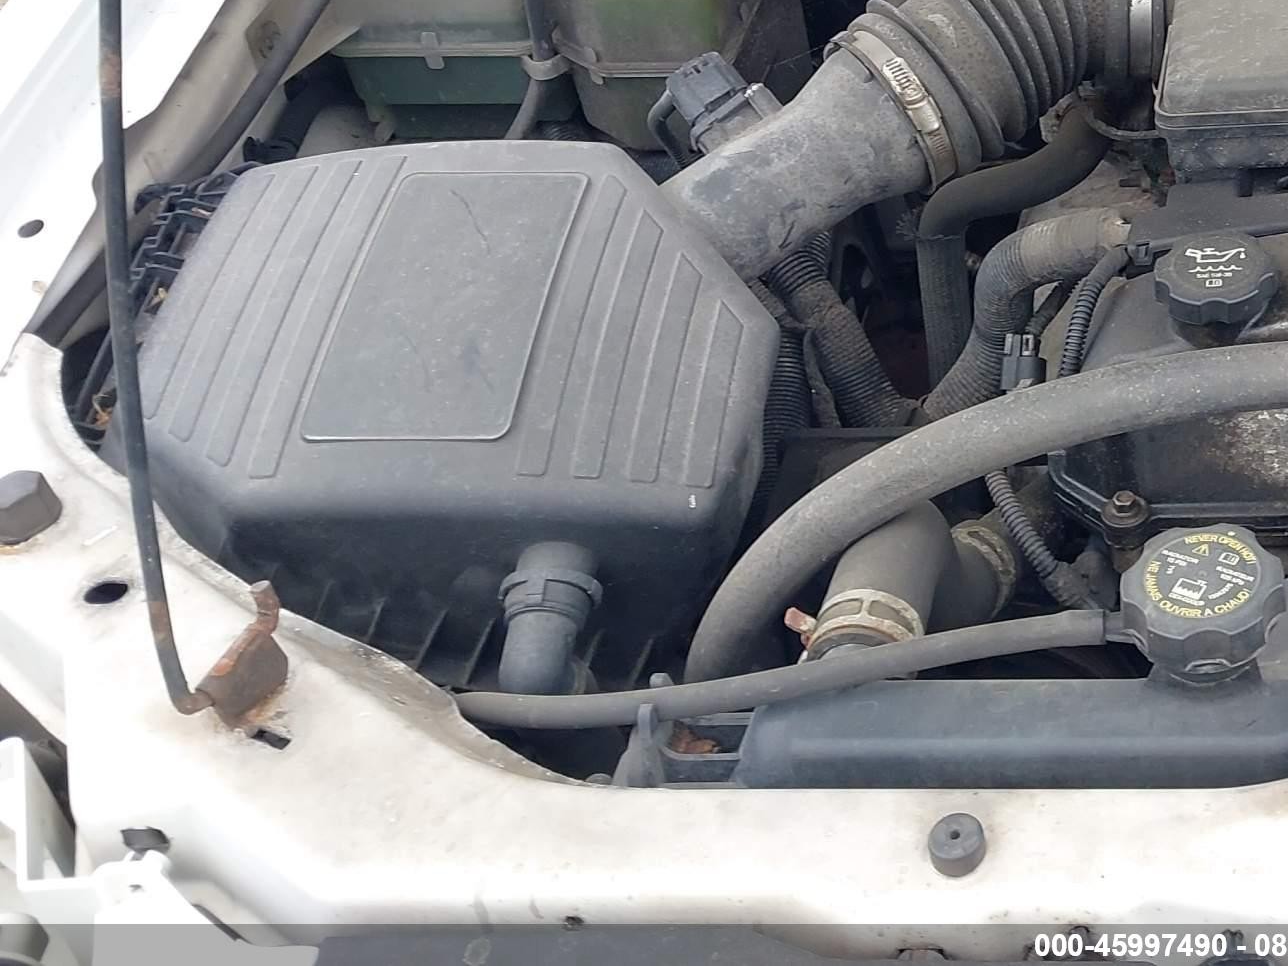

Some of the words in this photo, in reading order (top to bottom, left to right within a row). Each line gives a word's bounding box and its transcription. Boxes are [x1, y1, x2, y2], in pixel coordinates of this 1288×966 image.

[1184, 535, 1218, 544] NEVER
[1218, 535, 1241, 551] OPEN
[1161, 549, 1200, 565] RADIATOR
[1147, 560, 1162, 573] NE
[1144, 574, 1163, 601] JAMAIS
[1159, 600, 1202, 617] OUVRIR
